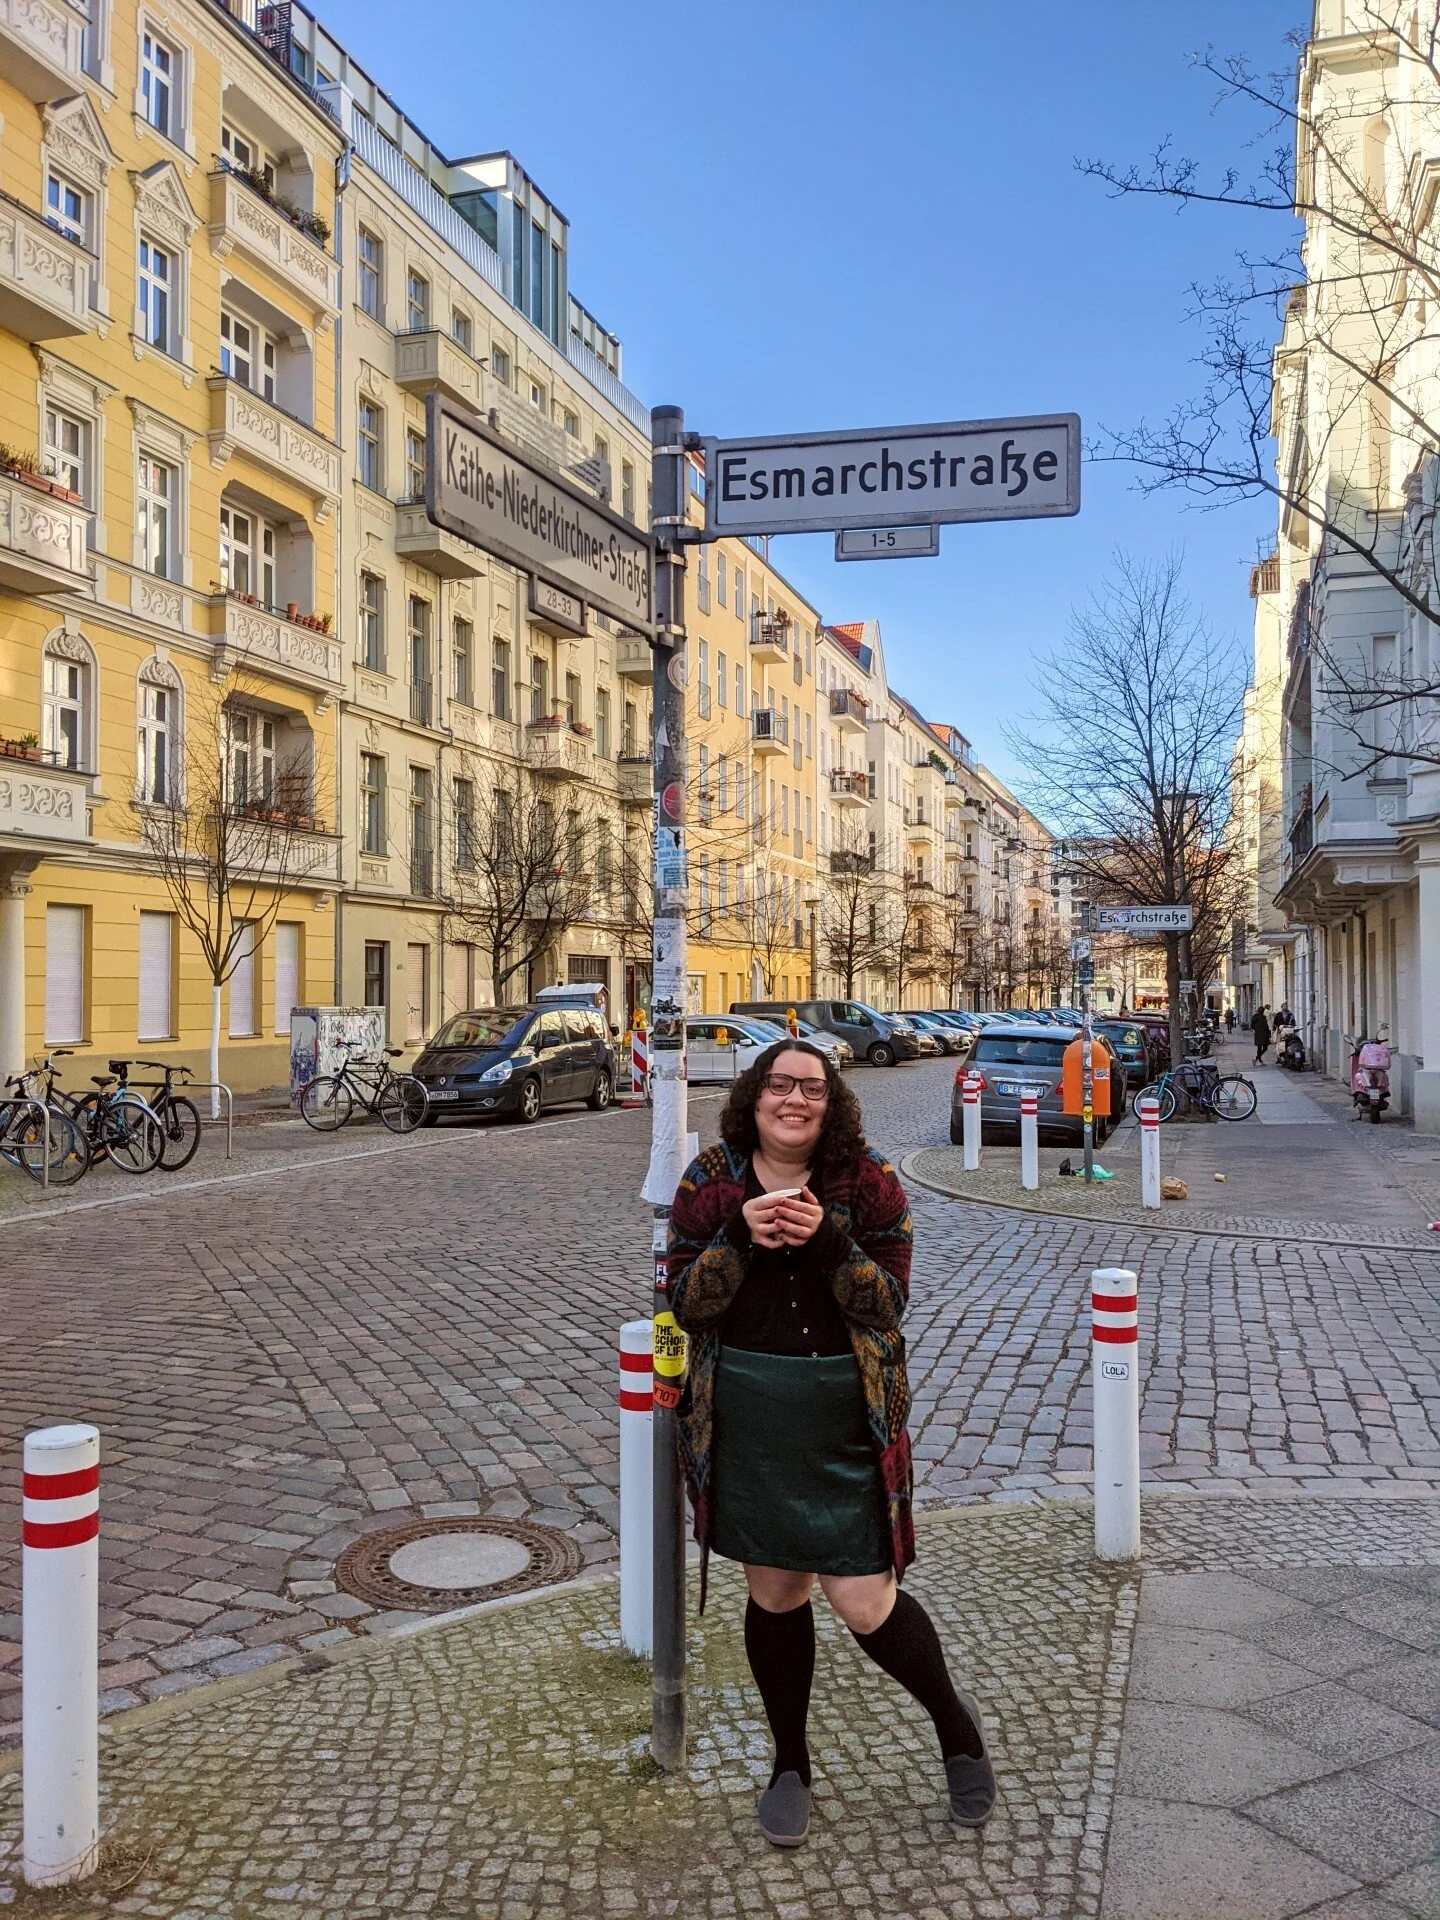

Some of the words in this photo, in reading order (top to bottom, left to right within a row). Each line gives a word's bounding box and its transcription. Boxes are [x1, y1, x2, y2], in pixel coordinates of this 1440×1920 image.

[722, 440, 1058, 501] Esmarchstraße
[446, 427, 648, 608] Käthe-Niederkirchner-Straße
[871, 532, 896, 547] 1-5
[546, 589, 572, 616] 28-33
[1099, 911, 1187, 925] Esarchstraße
[655, 1324, 673, 1336] THE
[654, 1345, 665, 1355] OF
[667, 1345, 685, 1357] LIFE
[1105, 1366, 1126, 1376] LOLA
